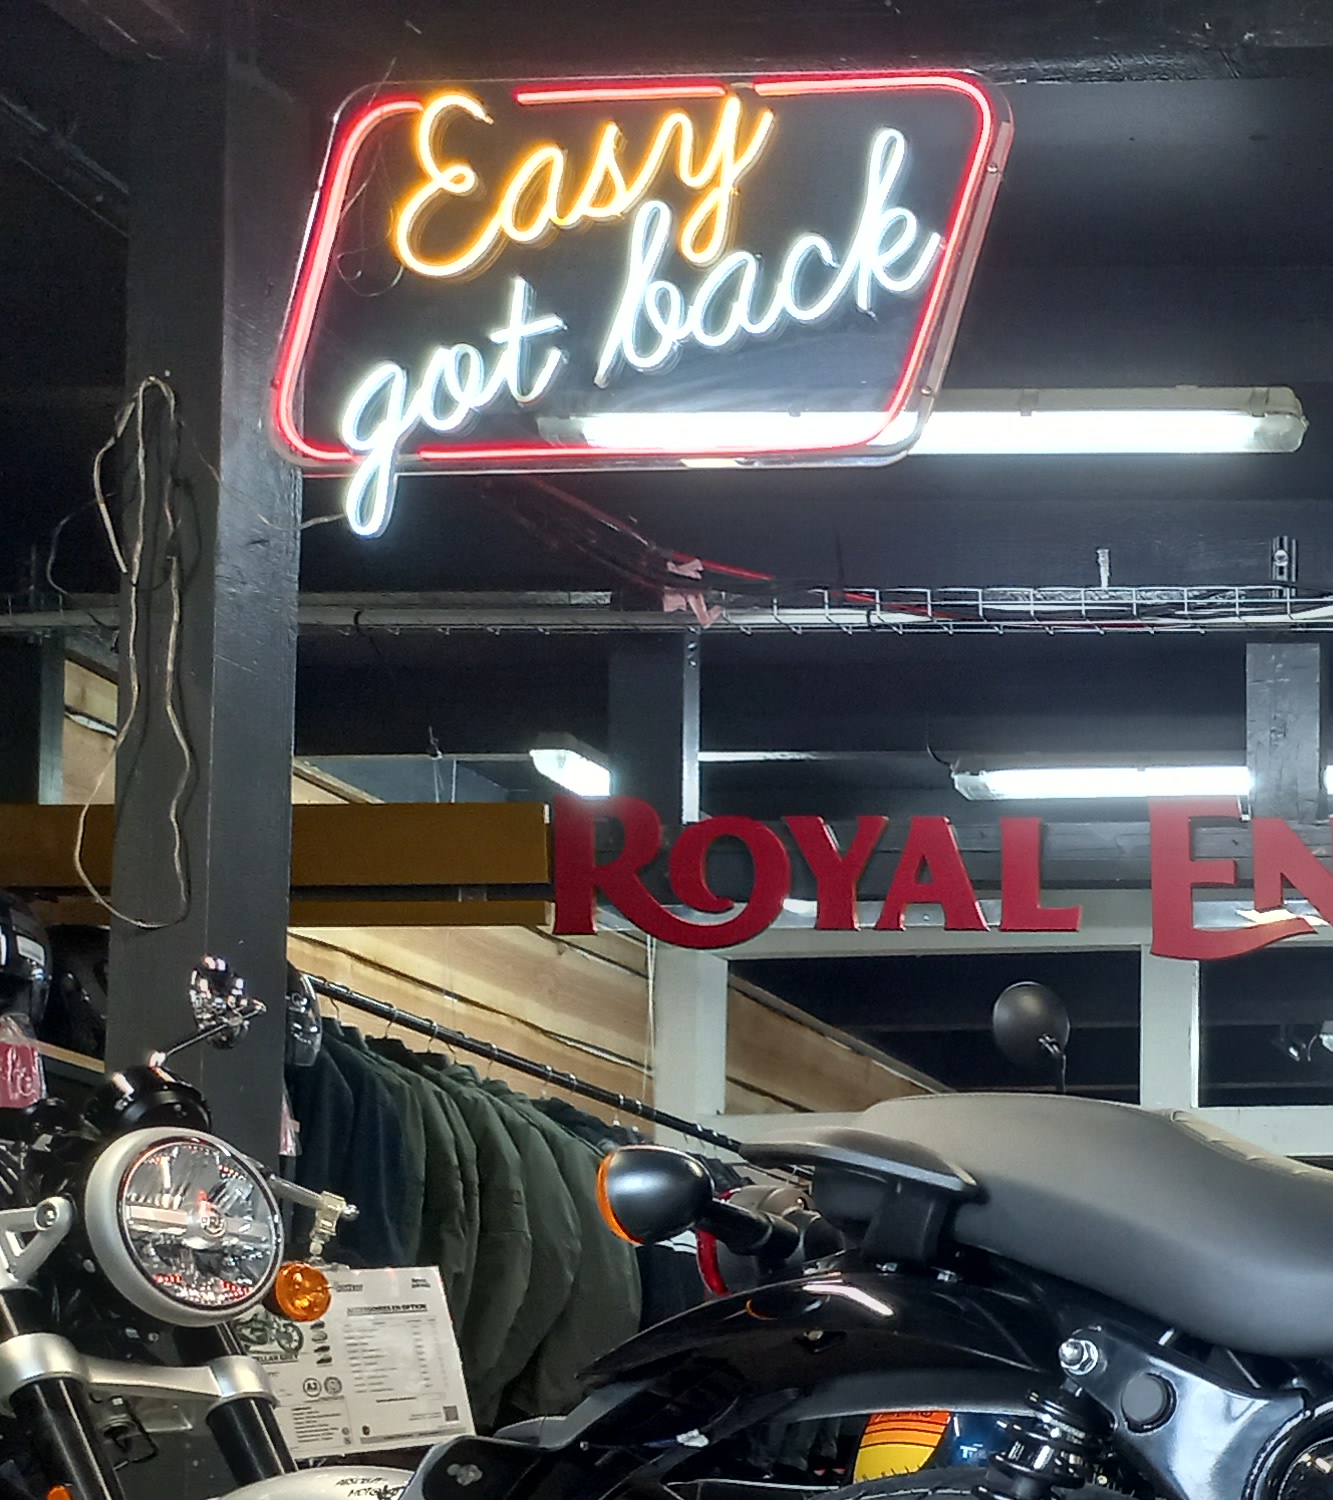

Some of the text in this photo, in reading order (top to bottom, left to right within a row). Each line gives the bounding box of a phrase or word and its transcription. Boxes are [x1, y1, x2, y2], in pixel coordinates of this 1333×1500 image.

[392, 91, 774, 280] Easy
[340, 128, 945, 540] got back
[551, 796, 1082, 950] ROYAL
